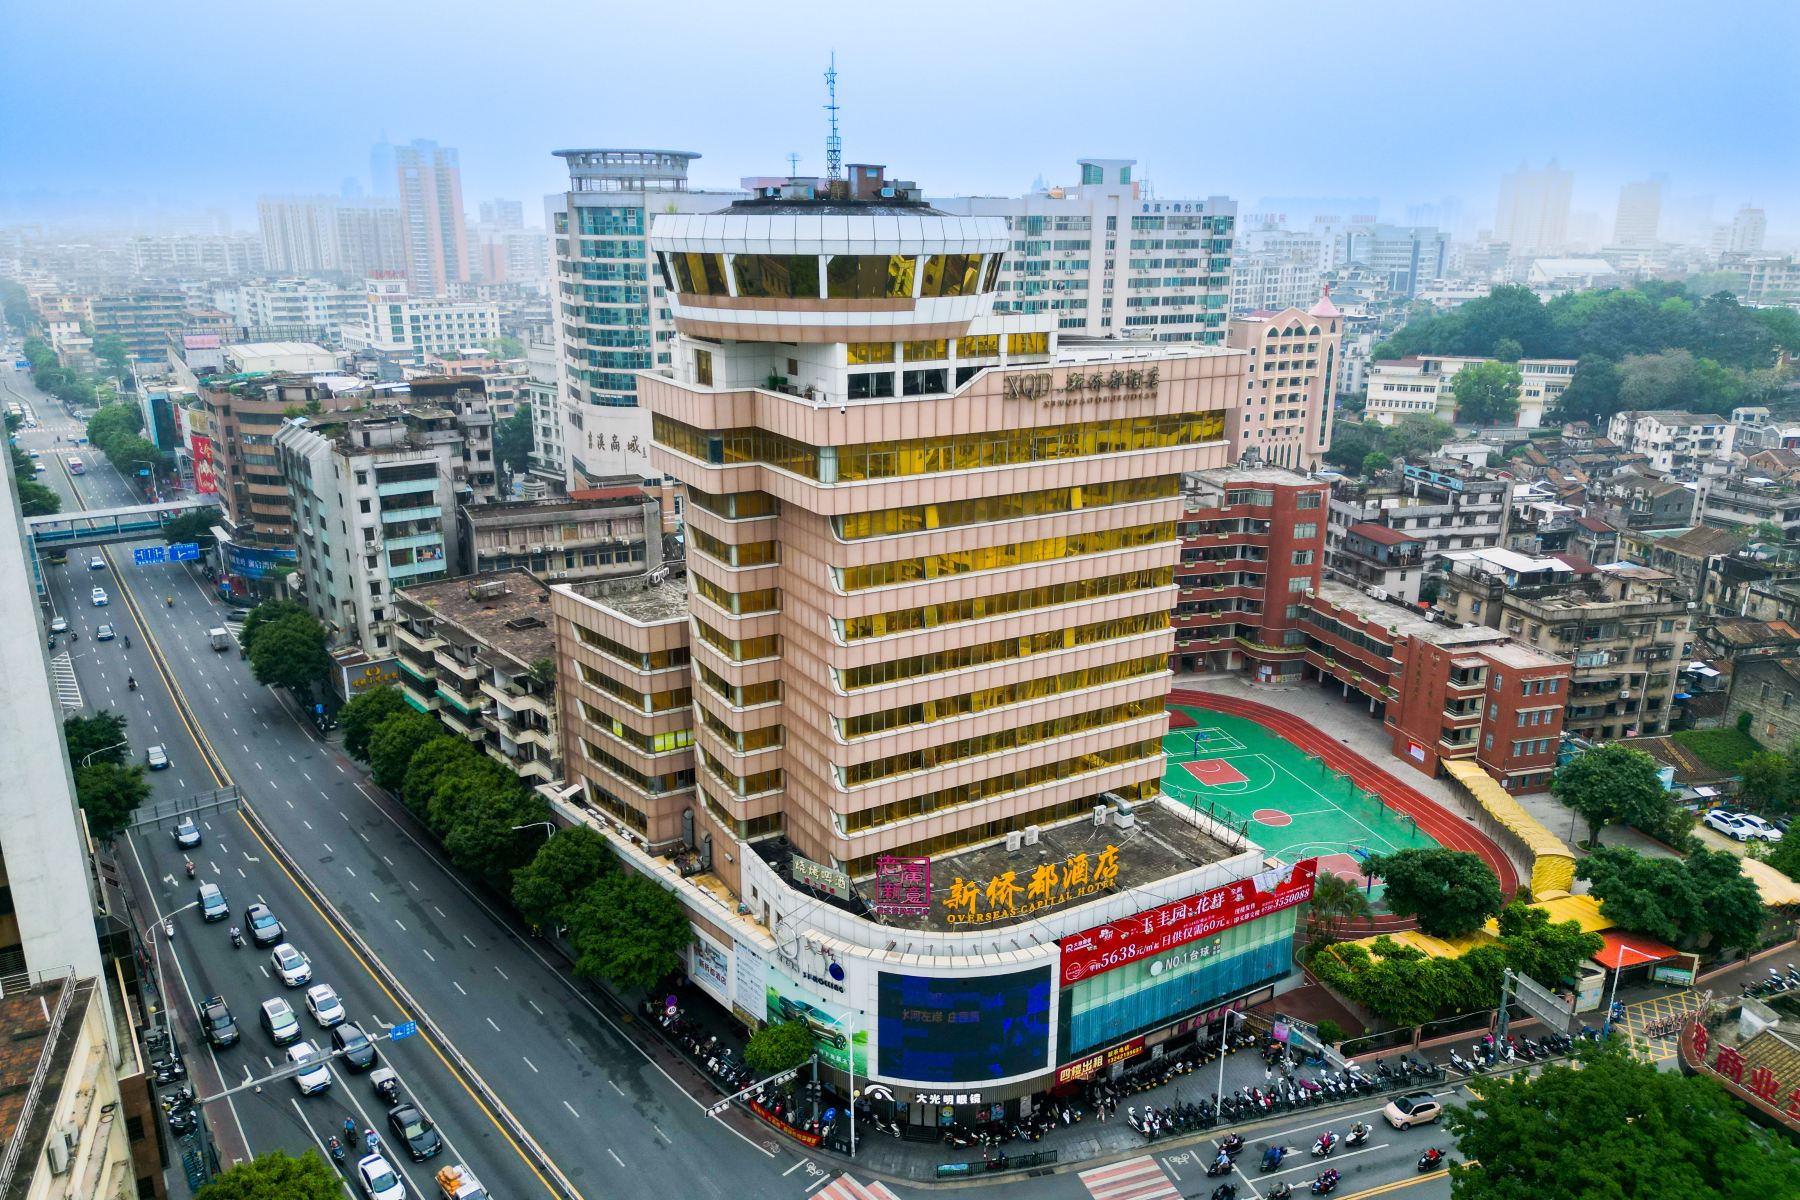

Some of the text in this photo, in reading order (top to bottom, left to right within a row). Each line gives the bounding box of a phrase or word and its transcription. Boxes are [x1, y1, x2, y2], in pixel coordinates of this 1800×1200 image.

[942, 844, 1119, 915] 新侨都酒店
[946, 878, 1116, 924] OVERSEAS CAPITAL HOTEL
[916, 1093, 981, 1105] 大光明眼镜
